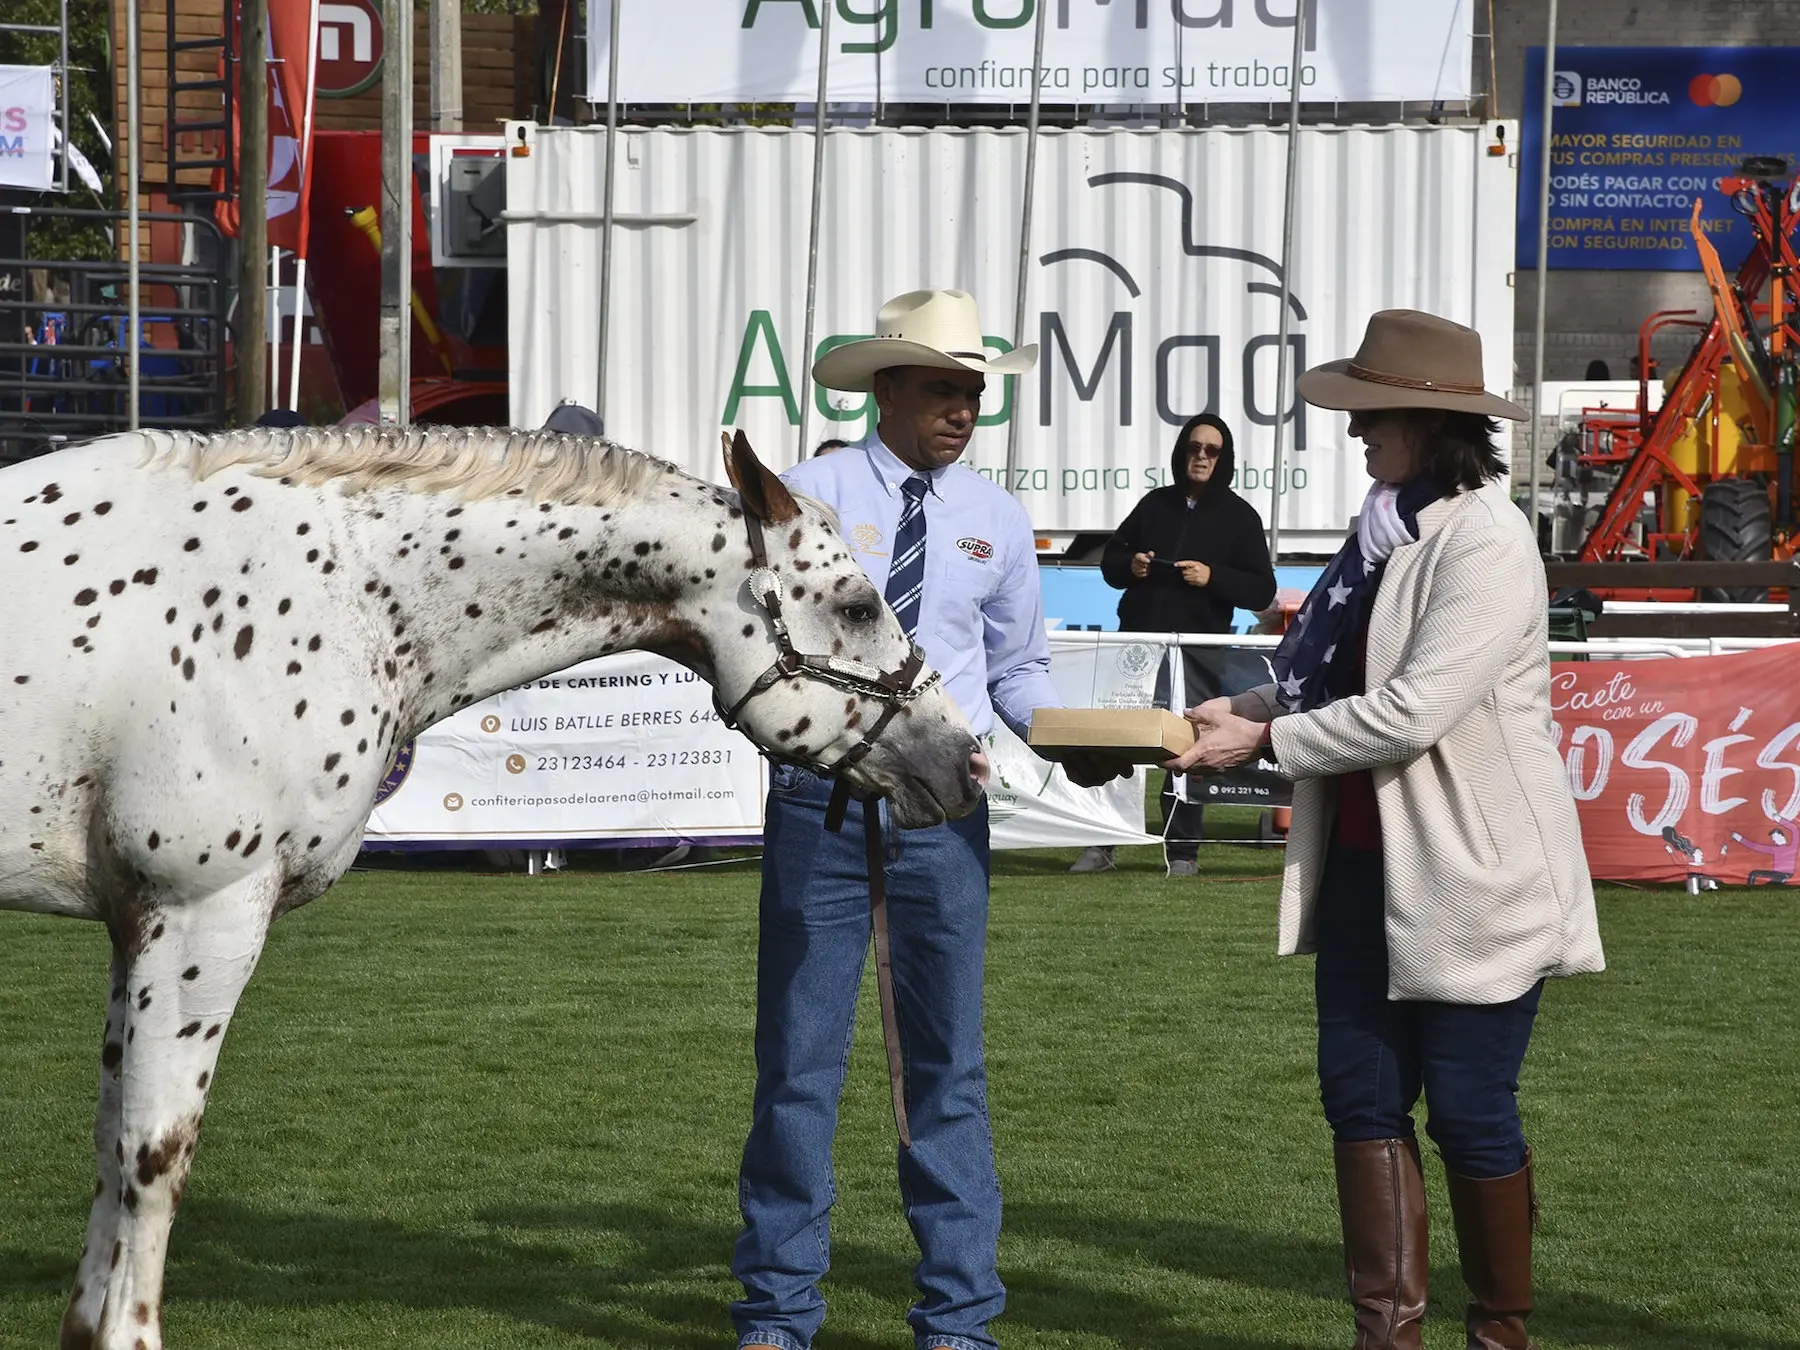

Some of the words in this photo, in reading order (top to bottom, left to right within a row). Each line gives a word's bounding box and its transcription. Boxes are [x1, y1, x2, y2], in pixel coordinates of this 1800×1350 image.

[926, 60, 1069, 88] confianza
[1083, 66, 1149, 94] para
[1162, 66, 1195, 88] su
[1207, 58, 1317, 93] trabao
[1587, 78, 1641, 91] BANCO
[1586, 90, 1670, 104] REPÚBLICA
[1612, 134, 1712, 149] SEGURIDAD
[1717, 135, 1742, 149] EN
[1580, 152, 1665, 166] COMPRAS
[1549, 172, 1600, 190] ODÉS
[1604, 176, 1662, 190] PAGAR
[1667, 176, 1707, 191] CON
[1560, 194, 1589, 208] SIN
[1593, 194, 1693, 209] CONTACTO.
[1548, 215, 1615, 231] OMPRÁ
[1621, 218, 1644, 232] EN
[1650, 218, 1734, 233] INTENET
[1584, 235, 1688, 250] SEGURIDAD.
[1063, 467, 1130, 496] para
[960, 541, 991, 556] SUPRA
[539, 679, 560, 690] DE
[568, 674, 652, 689] CATERING
[659, 673, 669, 685] Y
[1551, 672, 1636, 711] Caete
[1603, 705, 1635, 721] con
[1640, 700, 1664, 714] un
[511, 716, 548, 732] LUIS
[555, 714, 614, 731] BATLLE
[621, 710, 682, 727] BERRES
[537, 755, 626, 771] 23123464
[647, 750, 732, 768] 23123831
[1550, 705, 1800, 836] OSÉS
[471, 787, 735, 808] confiteriapasodelaarena@hotmail.com
[1238, 787, 1252, 795] 321
[1254, 787, 1270, 796] 963
